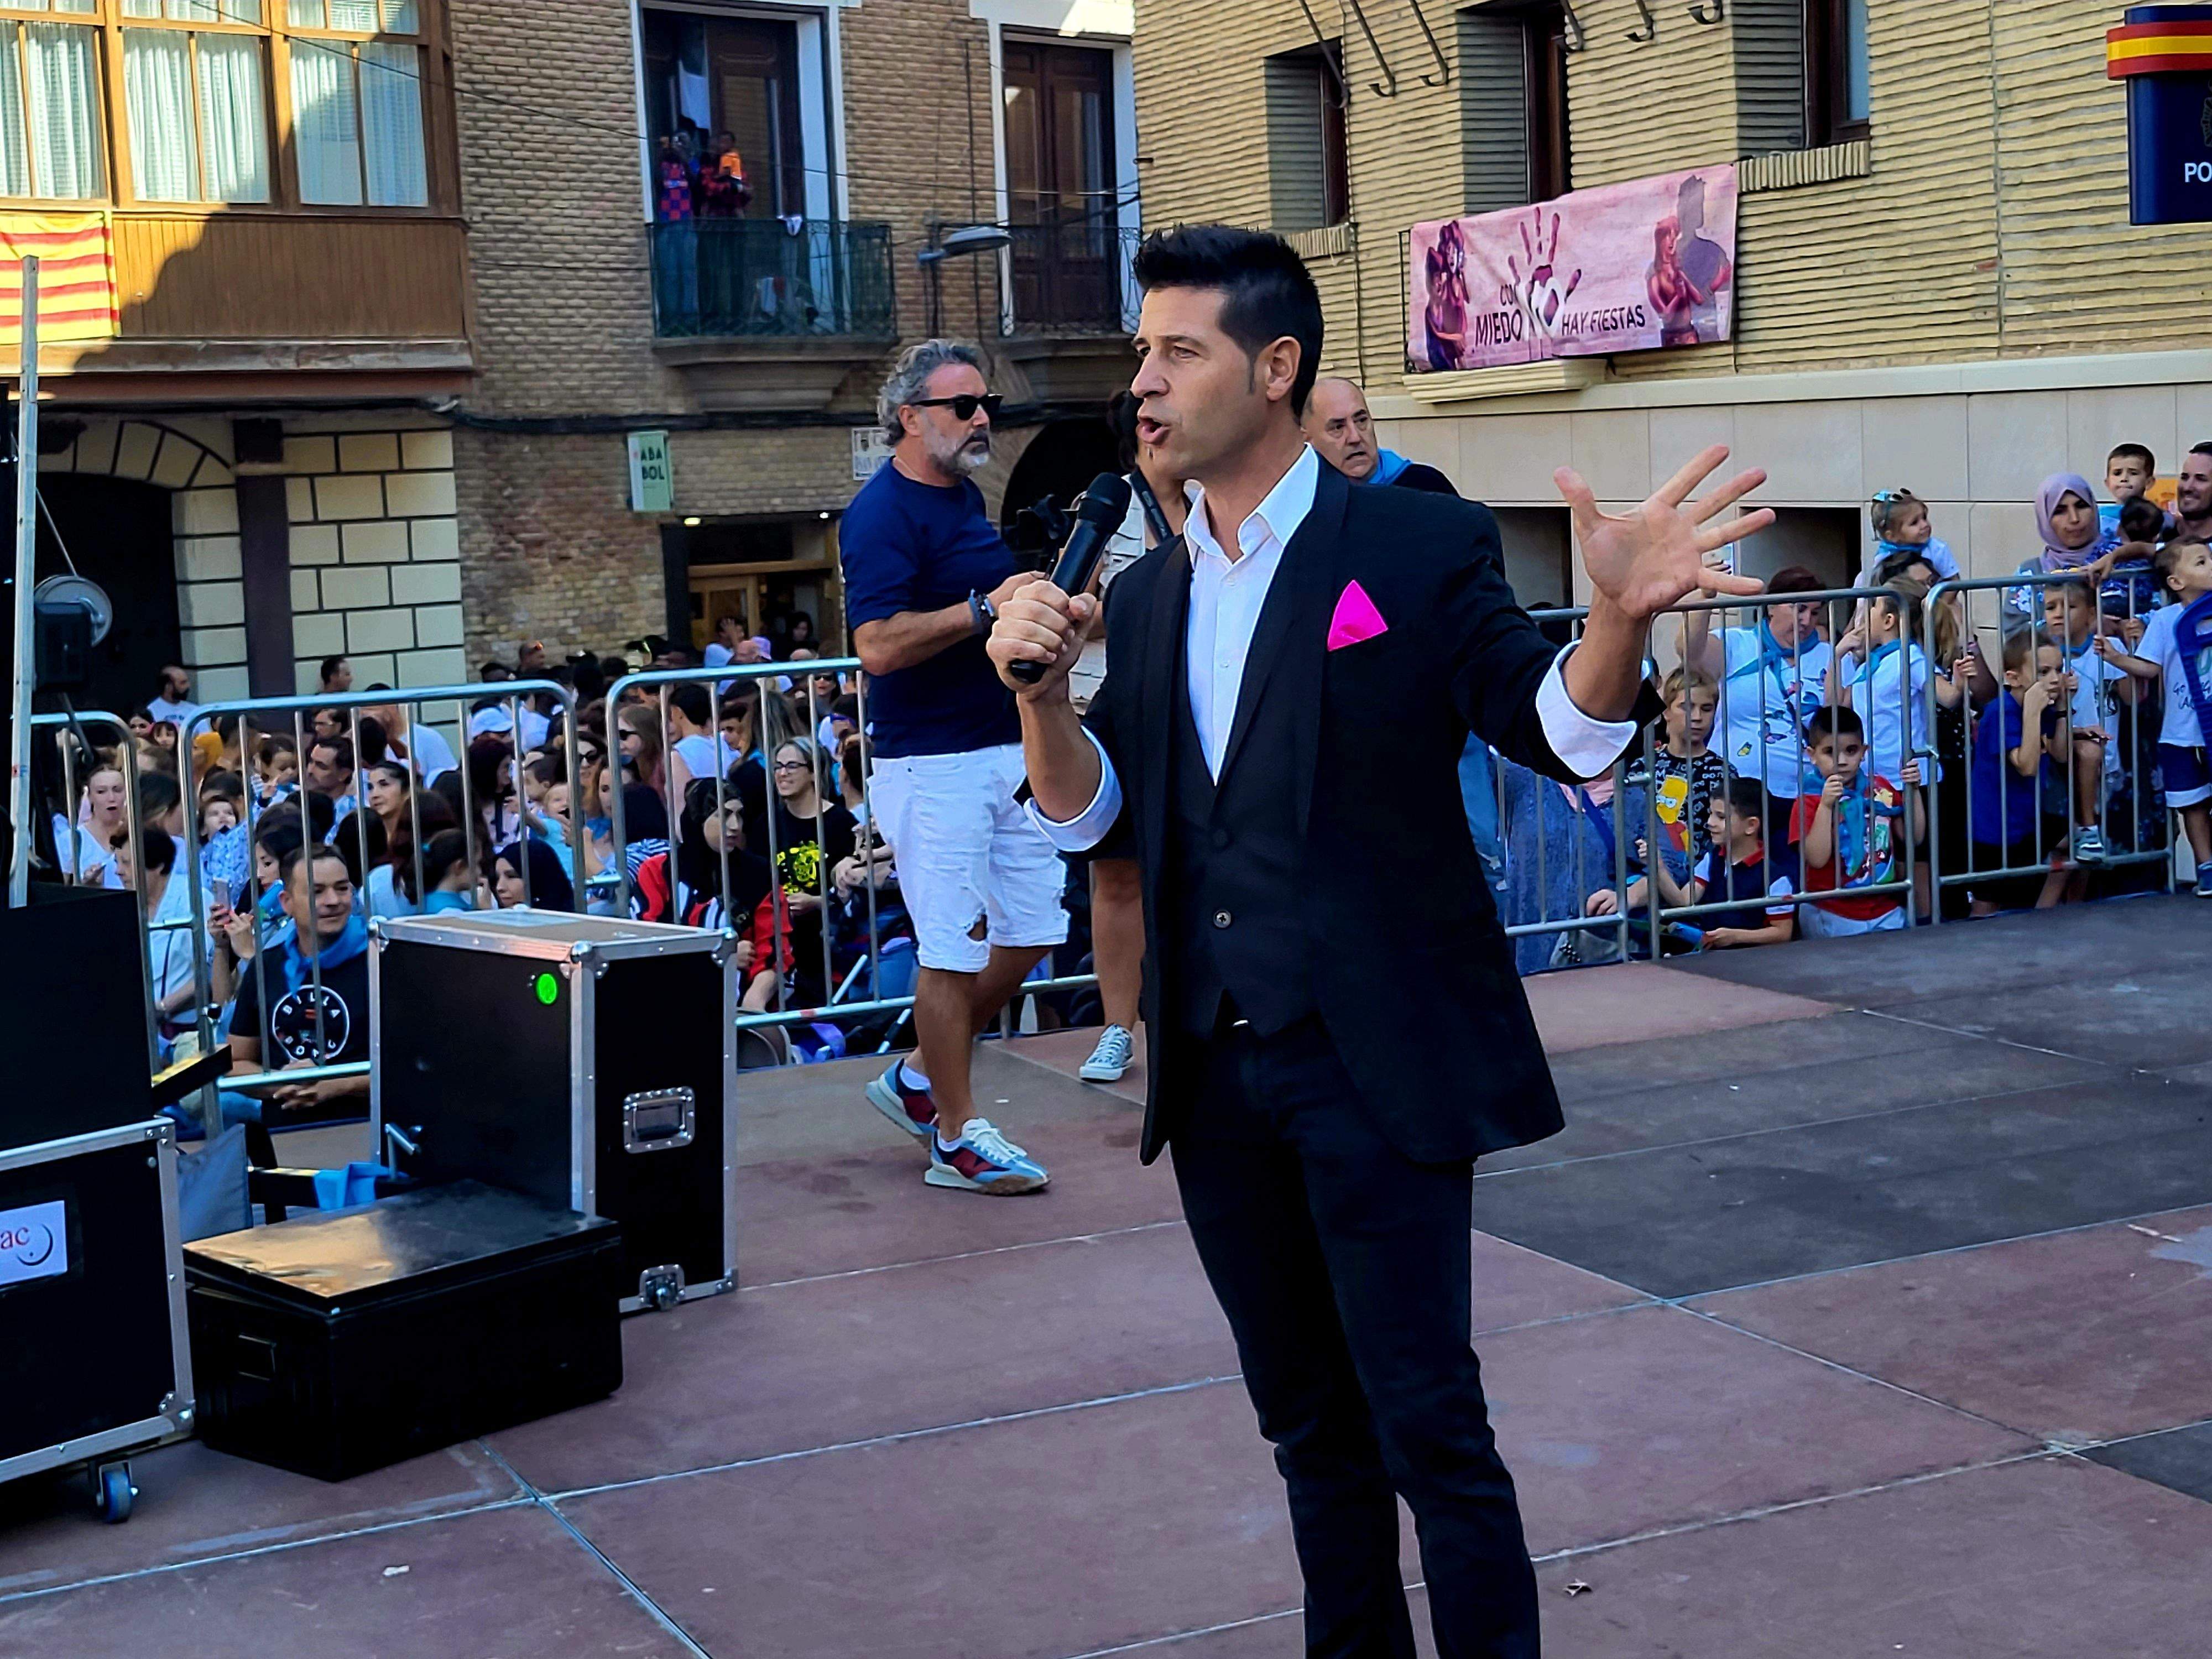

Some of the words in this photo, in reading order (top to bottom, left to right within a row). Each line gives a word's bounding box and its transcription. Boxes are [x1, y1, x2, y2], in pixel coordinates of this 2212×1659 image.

[1475, 309, 1522, 347] MIEDO
[1562, 311, 1588, 336] HAY
[1590, 305, 1646, 332] FIESTAS
[640, 447, 662, 461] ABA
[641, 466, 665, 480] BOL
